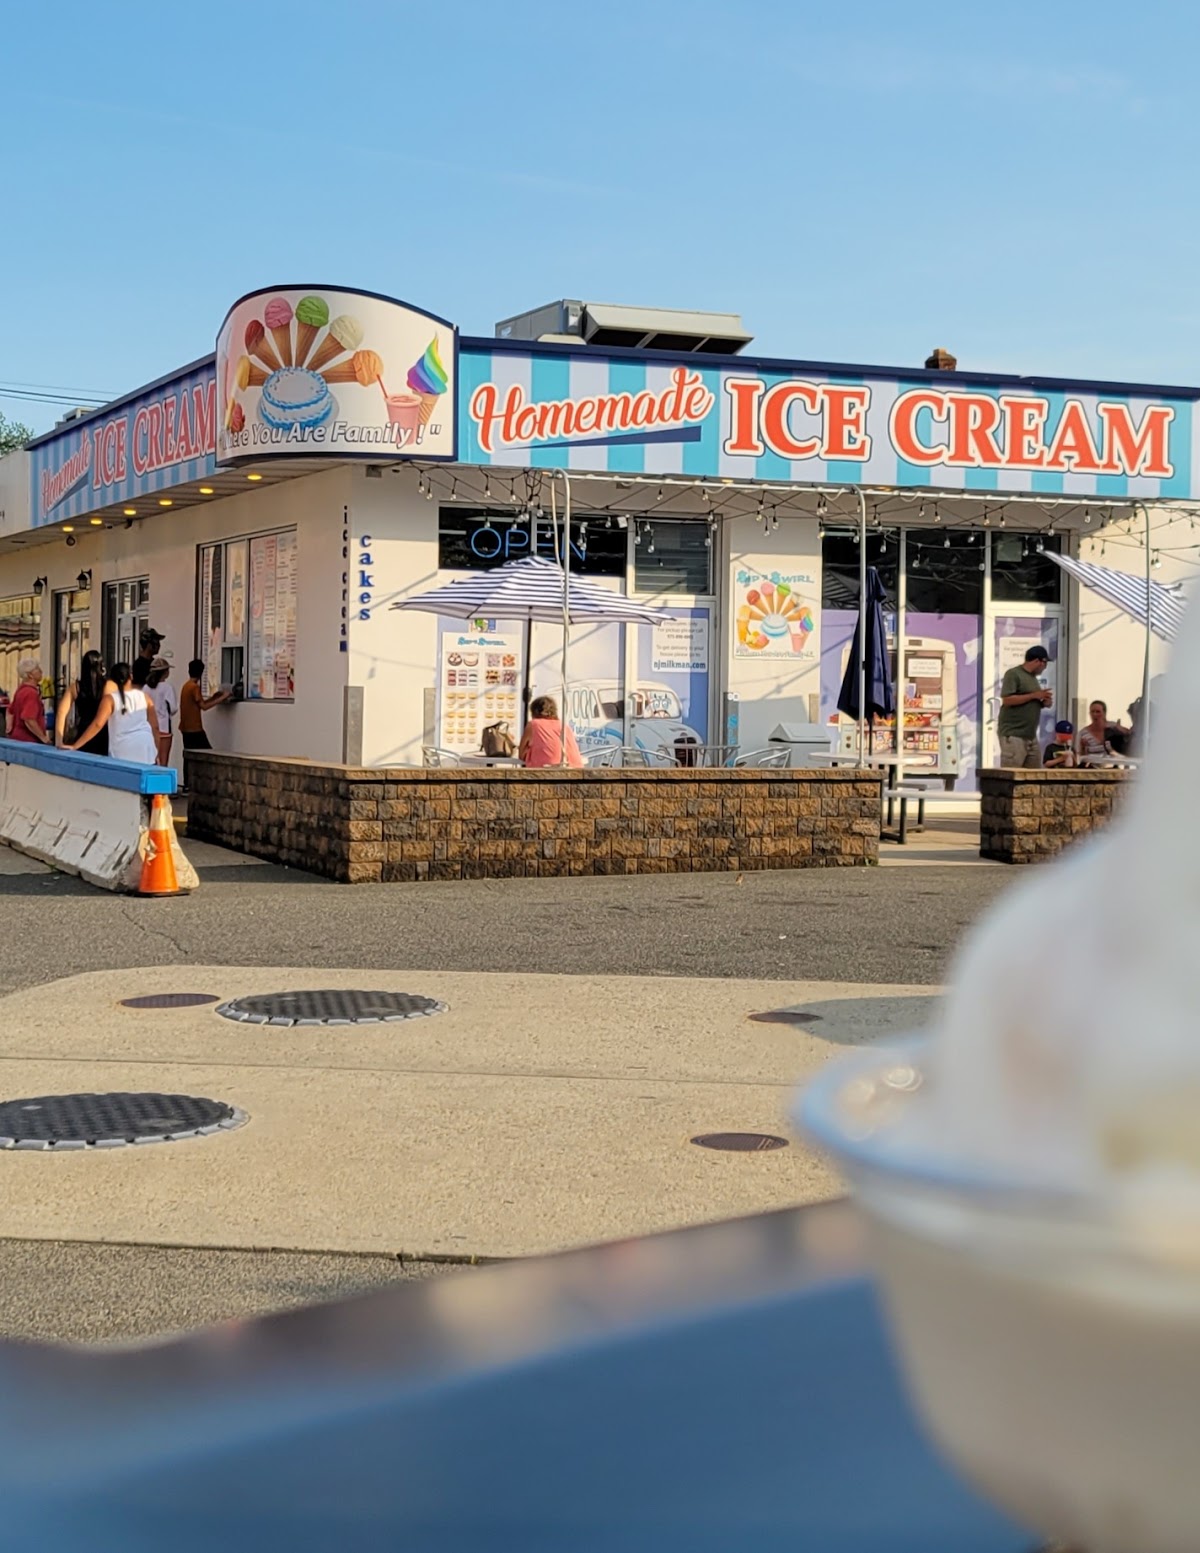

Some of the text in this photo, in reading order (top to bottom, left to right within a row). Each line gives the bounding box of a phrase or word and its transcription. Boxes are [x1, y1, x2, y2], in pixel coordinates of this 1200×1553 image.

[41, 379, 216, 518] Homemade ICE CREAM
[252, 423, 281, 444] You
[285, 421, 325, 443] Are
[472, 366, 1173, 476] Homemade ICE CREAM
[471, 527, 586, 561] OPEN
[358, 534, 374, 621] cakes
[653, 659, 706, 670] njmilkman.com
